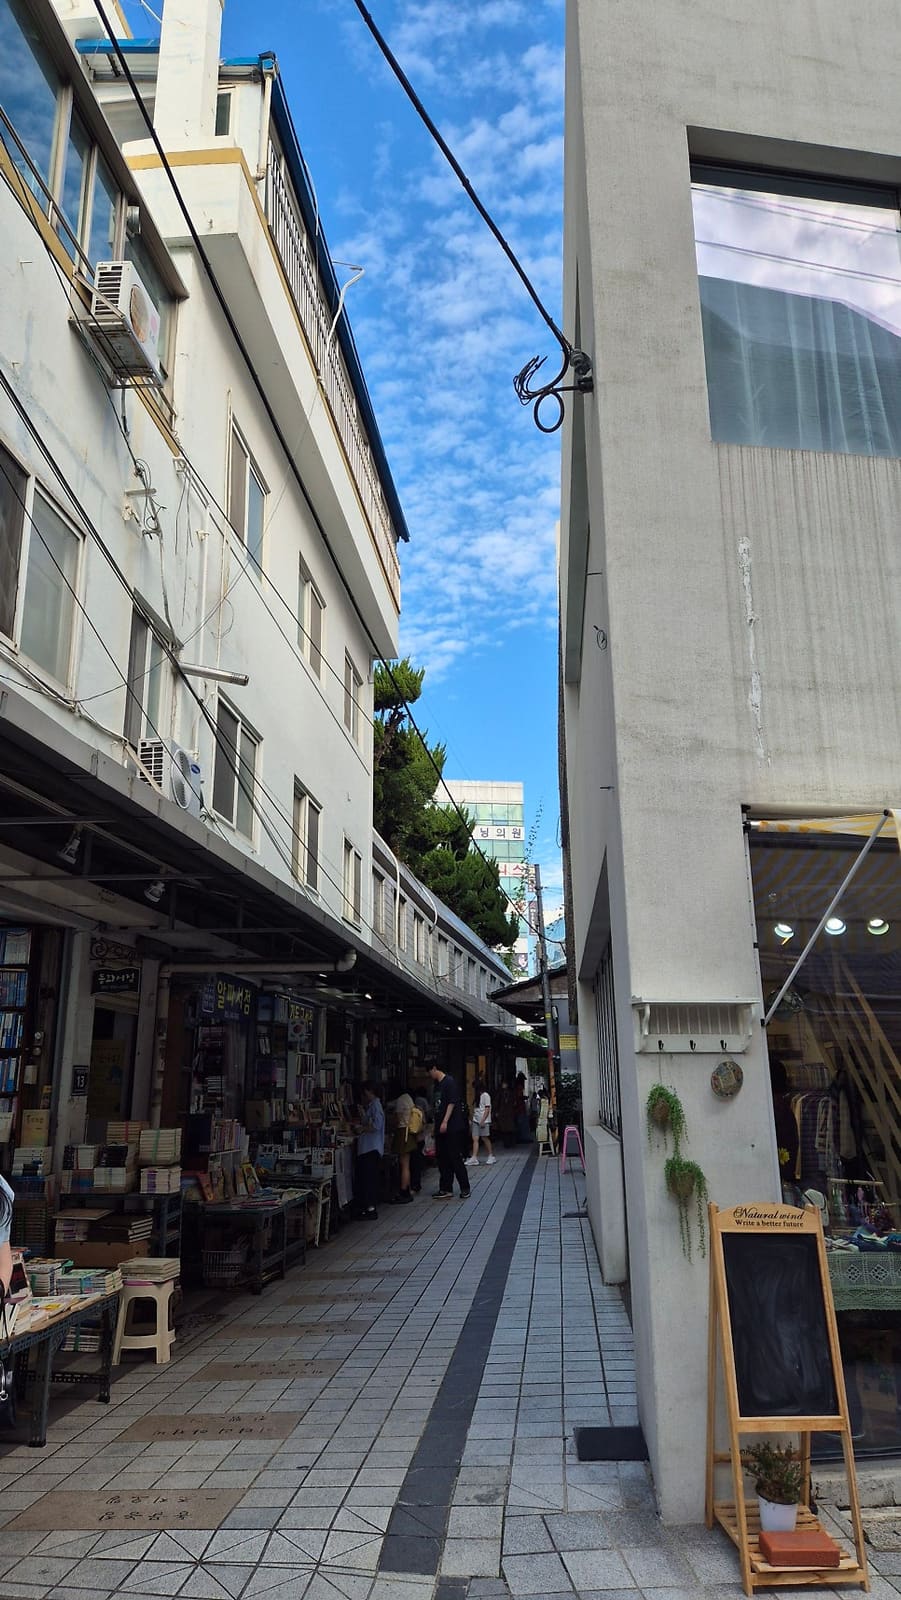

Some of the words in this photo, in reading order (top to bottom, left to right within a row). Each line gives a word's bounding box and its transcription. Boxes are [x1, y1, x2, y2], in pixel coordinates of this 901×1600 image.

[480, 827, 521, 839] 닝의원
[217, 980, 250, 1015] 알파서점
[733, 1206, 778, 1219] Natural
[779, 1211, 805, 1219] wind
